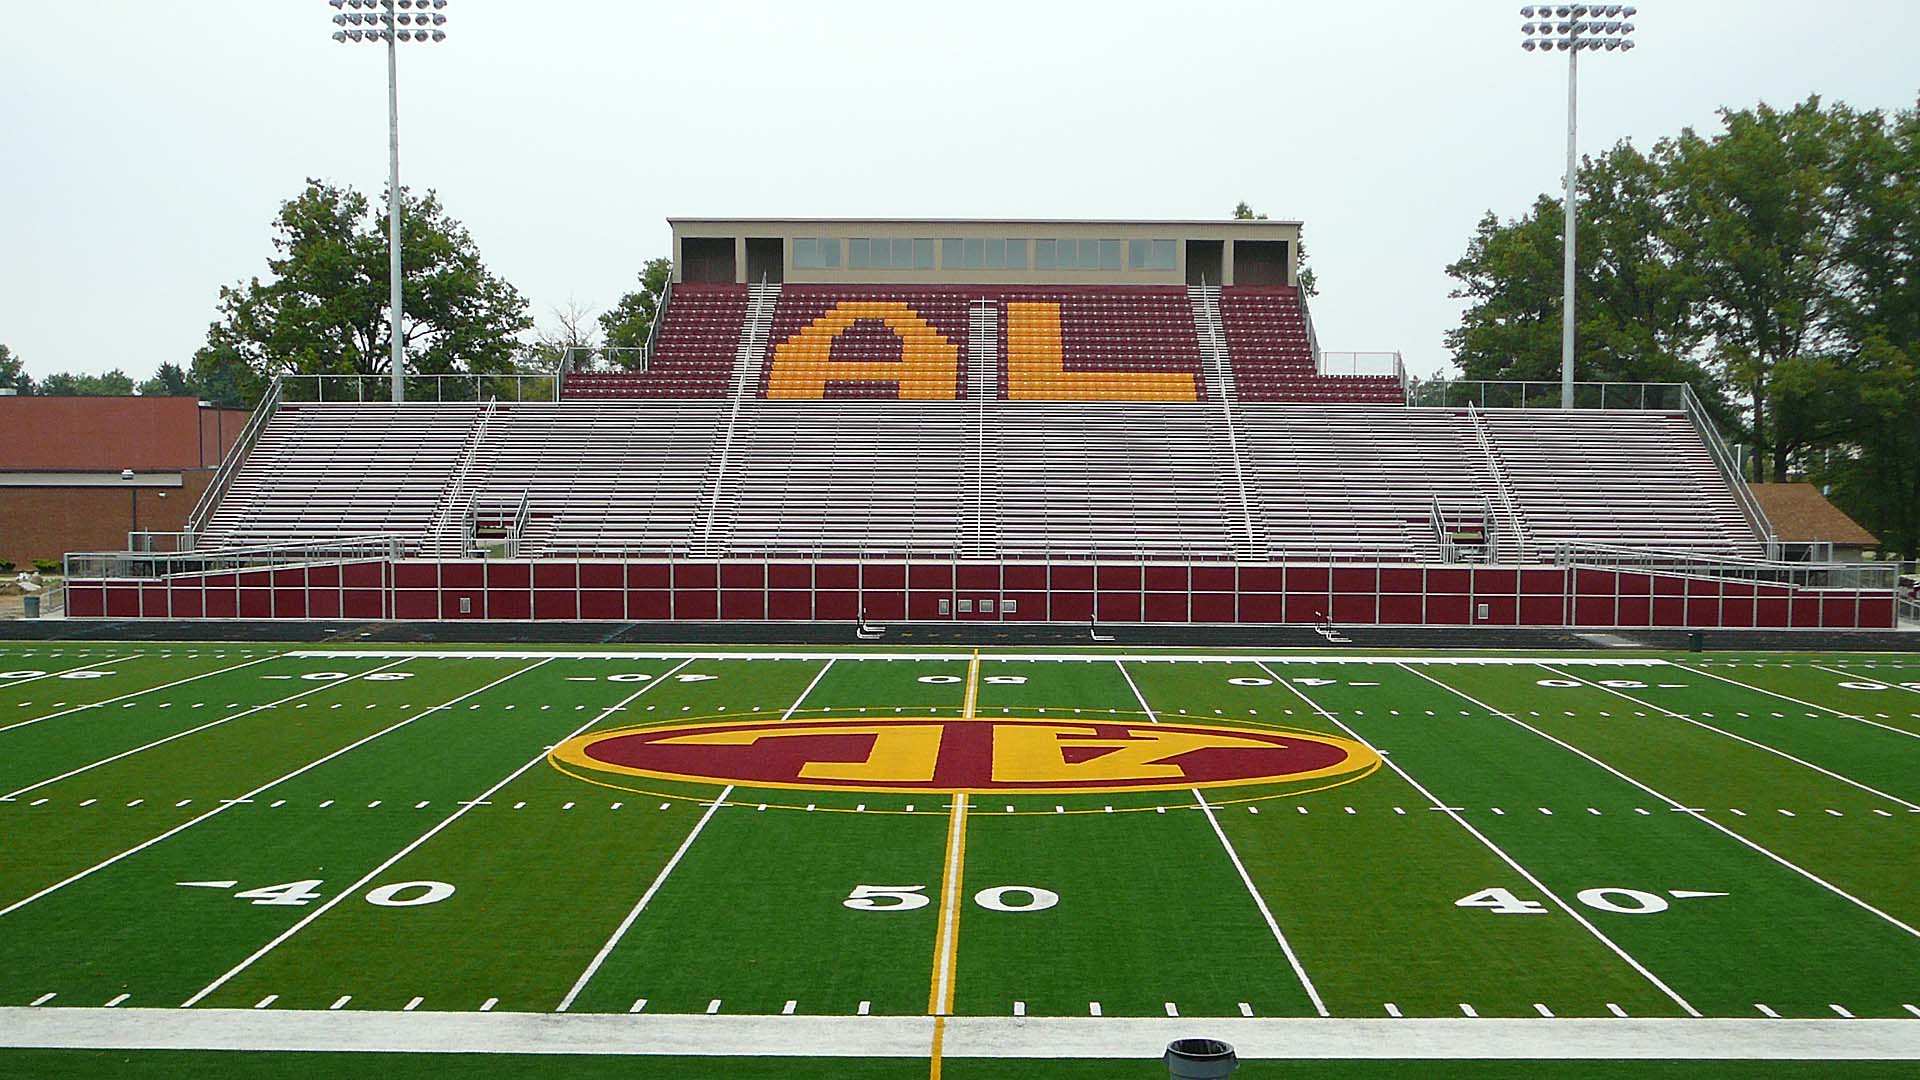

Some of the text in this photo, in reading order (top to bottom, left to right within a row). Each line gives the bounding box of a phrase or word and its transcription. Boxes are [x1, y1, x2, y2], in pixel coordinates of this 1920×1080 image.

[766, 301, 1197, 399] AL
[917, 676, 1029, 684] 50
[233, 879, 456, 906] 40
[842, 885, 1060, 912] 50
[1454, 888, 1669, 914] 40
